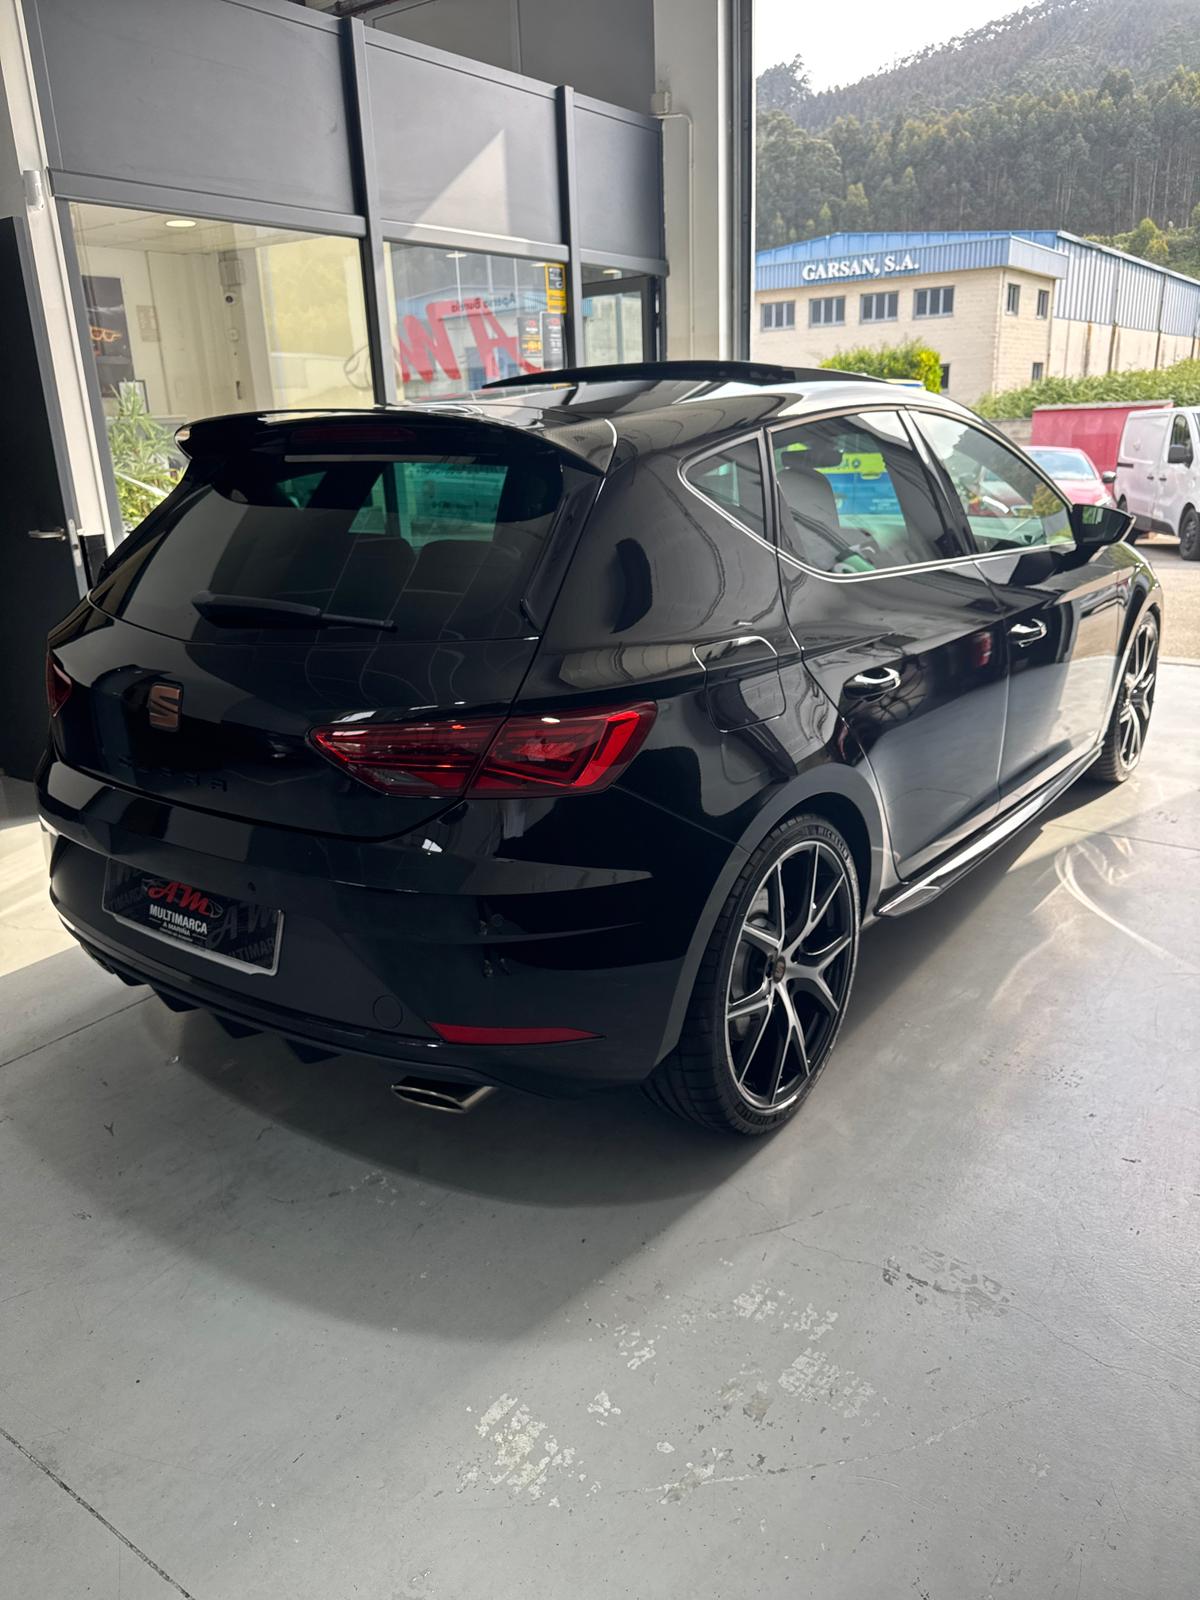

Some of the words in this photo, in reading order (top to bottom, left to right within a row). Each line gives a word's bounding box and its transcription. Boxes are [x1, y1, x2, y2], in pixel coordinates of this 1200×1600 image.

[802, 258, 880, 280] GARSAN,
[884, 254, 919, 272] S.A.
[150, 904, 208, 934] MULTIMARCA
